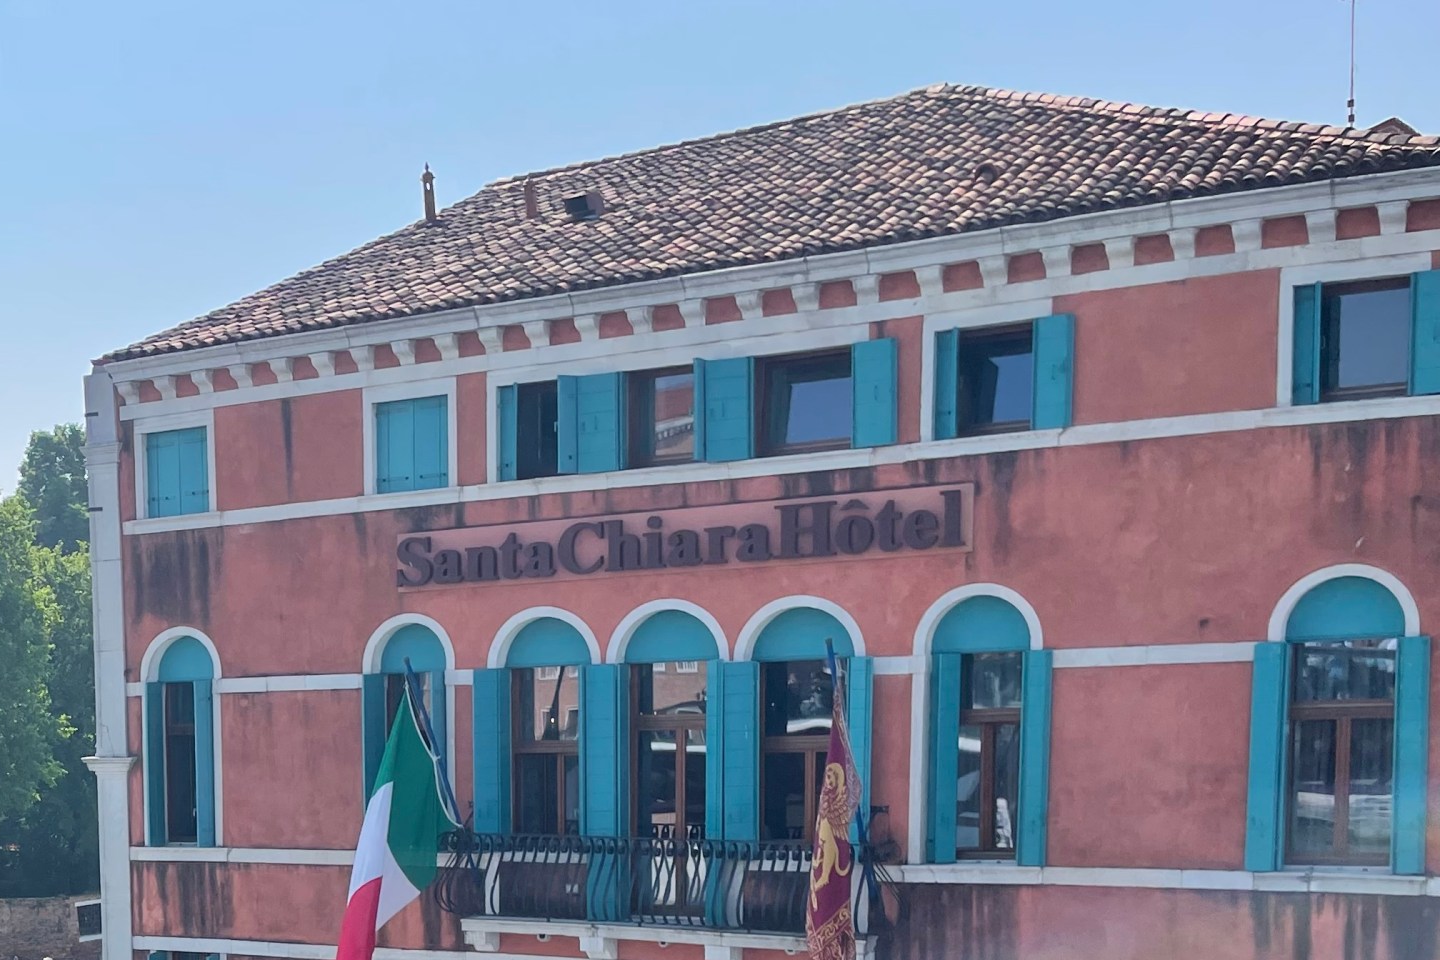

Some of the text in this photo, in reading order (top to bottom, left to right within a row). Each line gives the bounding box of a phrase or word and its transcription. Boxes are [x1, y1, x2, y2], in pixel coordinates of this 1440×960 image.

[396, 489, 967, 588] Santa Chiara Hôtel
